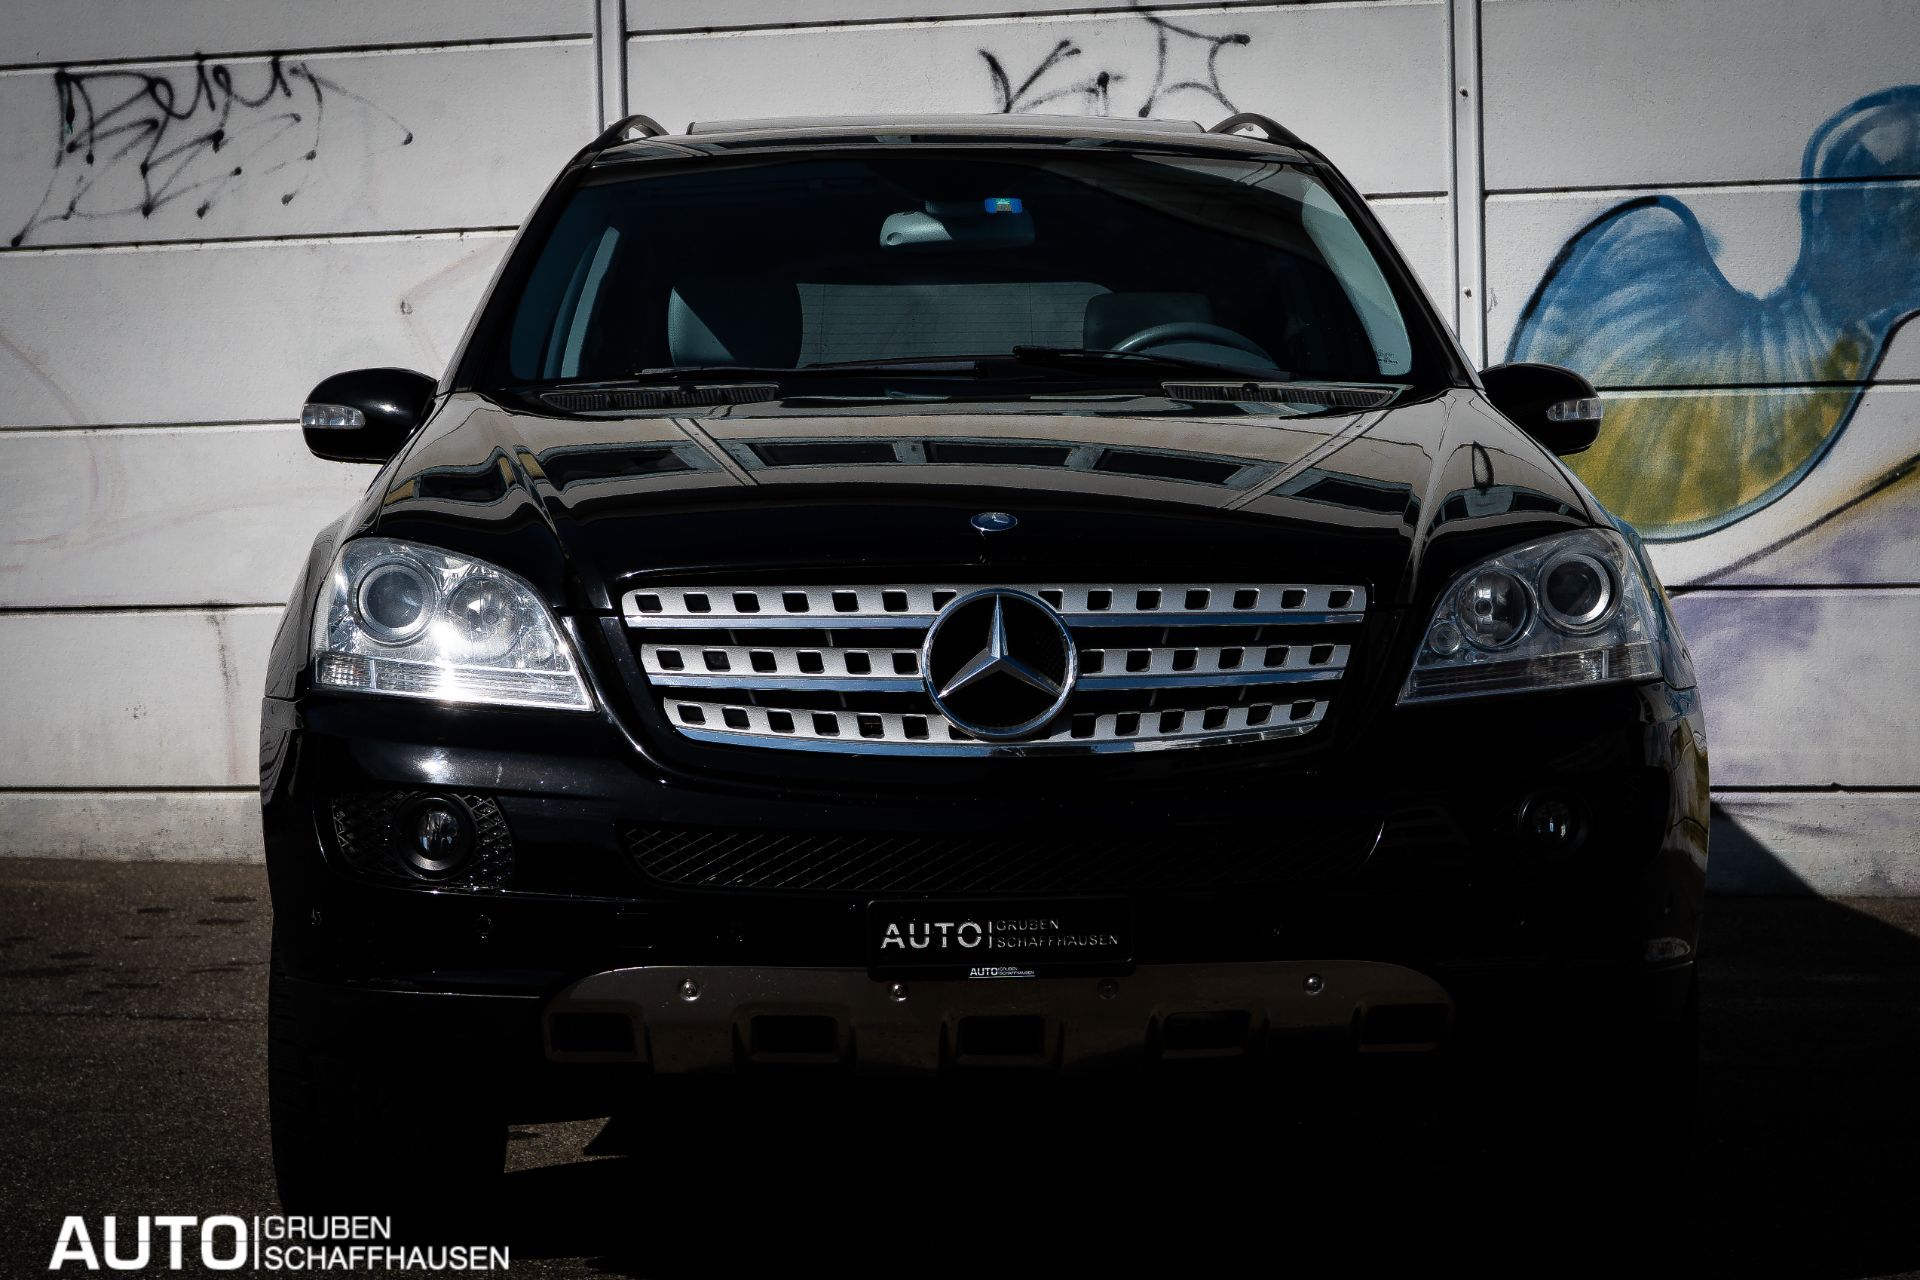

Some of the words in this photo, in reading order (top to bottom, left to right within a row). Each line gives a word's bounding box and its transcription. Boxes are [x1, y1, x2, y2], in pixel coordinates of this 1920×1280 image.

[995, 919, 1059, 931] GRUBEN
[880, 921, 982, 949] AUTO
[997, 934, 1118, 948] SCHAFFHAUSEN
[969, 967, 998, 976] AUTO
